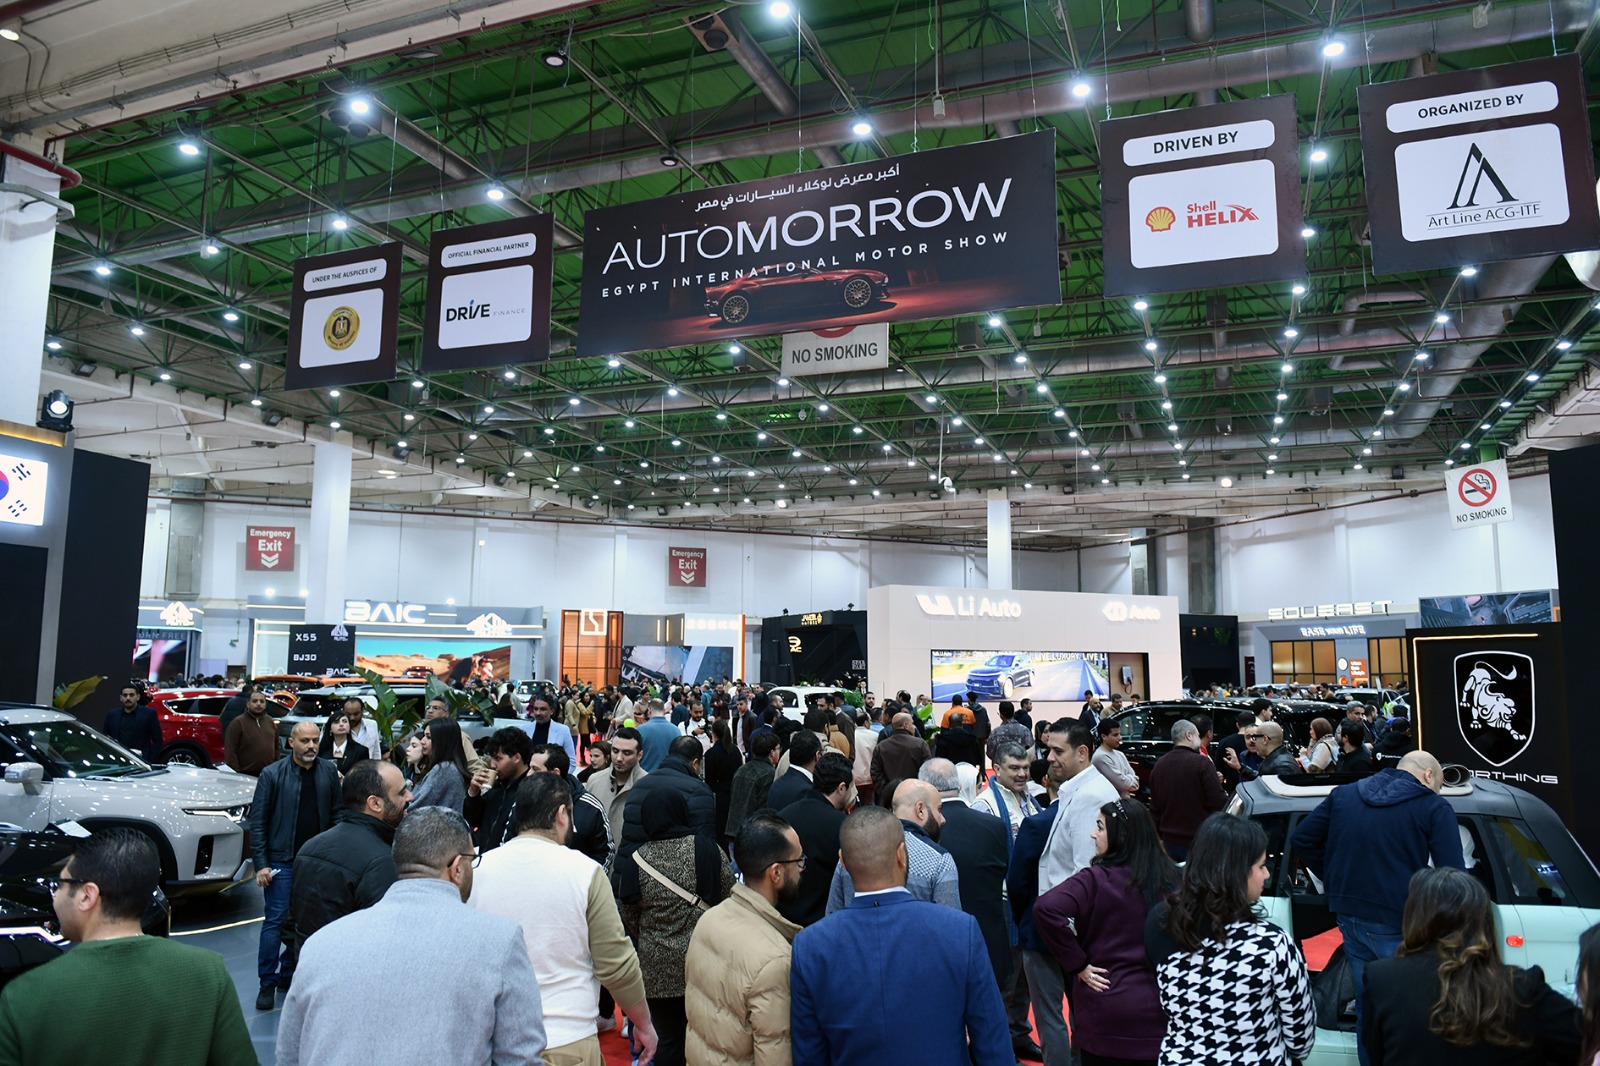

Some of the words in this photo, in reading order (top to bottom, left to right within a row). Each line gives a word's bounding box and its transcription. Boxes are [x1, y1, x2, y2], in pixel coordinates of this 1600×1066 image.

[1418, 97, 1502, 118] ORGANIZED
[1506, 94, 1524, 106] BY
[1153, 135, 1213, 154] DRIVEN
[1218, 131, 1238, 145] BY
[834, 173, 873, 188] معرض
[875, 163, 900, 181] أكبر
[797, 177, 832, 193] لوكلاء
[695, 199, 719, 212] مصر
[720, 193, 734, 211] في
[1187, 201, 1216, 214] Shell
[1187, 205, 1260, 229] HELIX
[1428, 216, 1449, 228] Art
[1453, 213, 1482, 225] Line
[1485, 204, 1540, 221] ACG-ITF
[602, 178, 1012, 275] AUTOMORROW
[448, 251, 472, 259] OFFICIAL
[473, 246, 502, 255] FINANCIAL
[503, 242, 529, 250] PARTNER
[602, 281, 659, 298] EGYPT
[673, 256, 839, 287] INTERNATIONAL
[855, 243, 928, 262] MOTOR
[944, 232, 1007, 250] SHOW
[312, 274, 330, 283] UNDER
[343, 268, 368, 278] AUSPICES
[493, 308, 526, 316] FINANCE
[792, 349, 811, 364] NO
[815, 342, 878, 361] SMOKING
[1456, 514, 1468, 523] NO
[1469, 507, 1507, 521] SMOKING
[250, 529, 291, 539] Emergency
[258, 539, 282, 551] Exit
[672, 550, 704, 559] Emergency
[679, 559, 697, 570] Exit
[344, 601, 426, 624] BAIC
[958, 596, 974, 616] Li
[978, 597, 1021, 618] Auto
[1268, 600, 1393, 620] SOUEAST
[295, 633, 317, 642] X55
